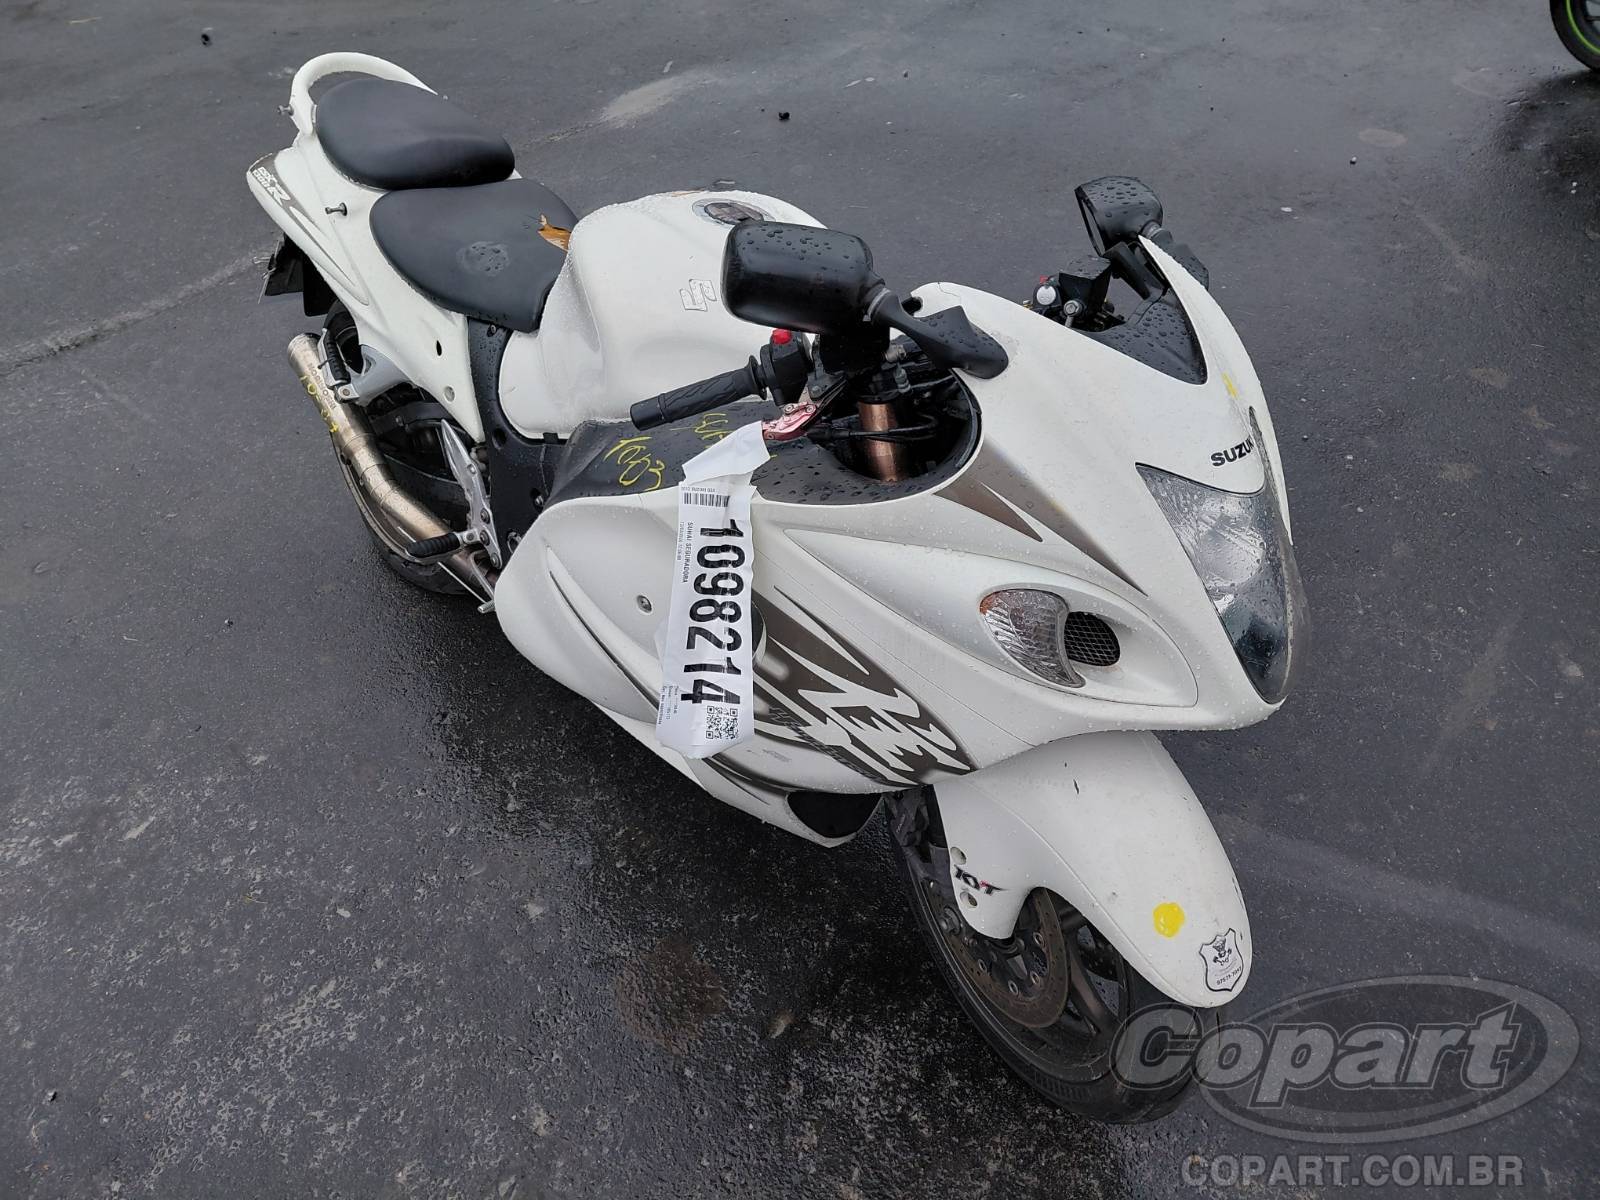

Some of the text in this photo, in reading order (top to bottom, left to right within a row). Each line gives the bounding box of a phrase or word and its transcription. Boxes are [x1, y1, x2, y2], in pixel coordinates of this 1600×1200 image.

[1210, 435, 1255, 467] SUZUK
[682, 542, 692, 583] SEGURADORA
[681, 518, 746, 705] 1098214
